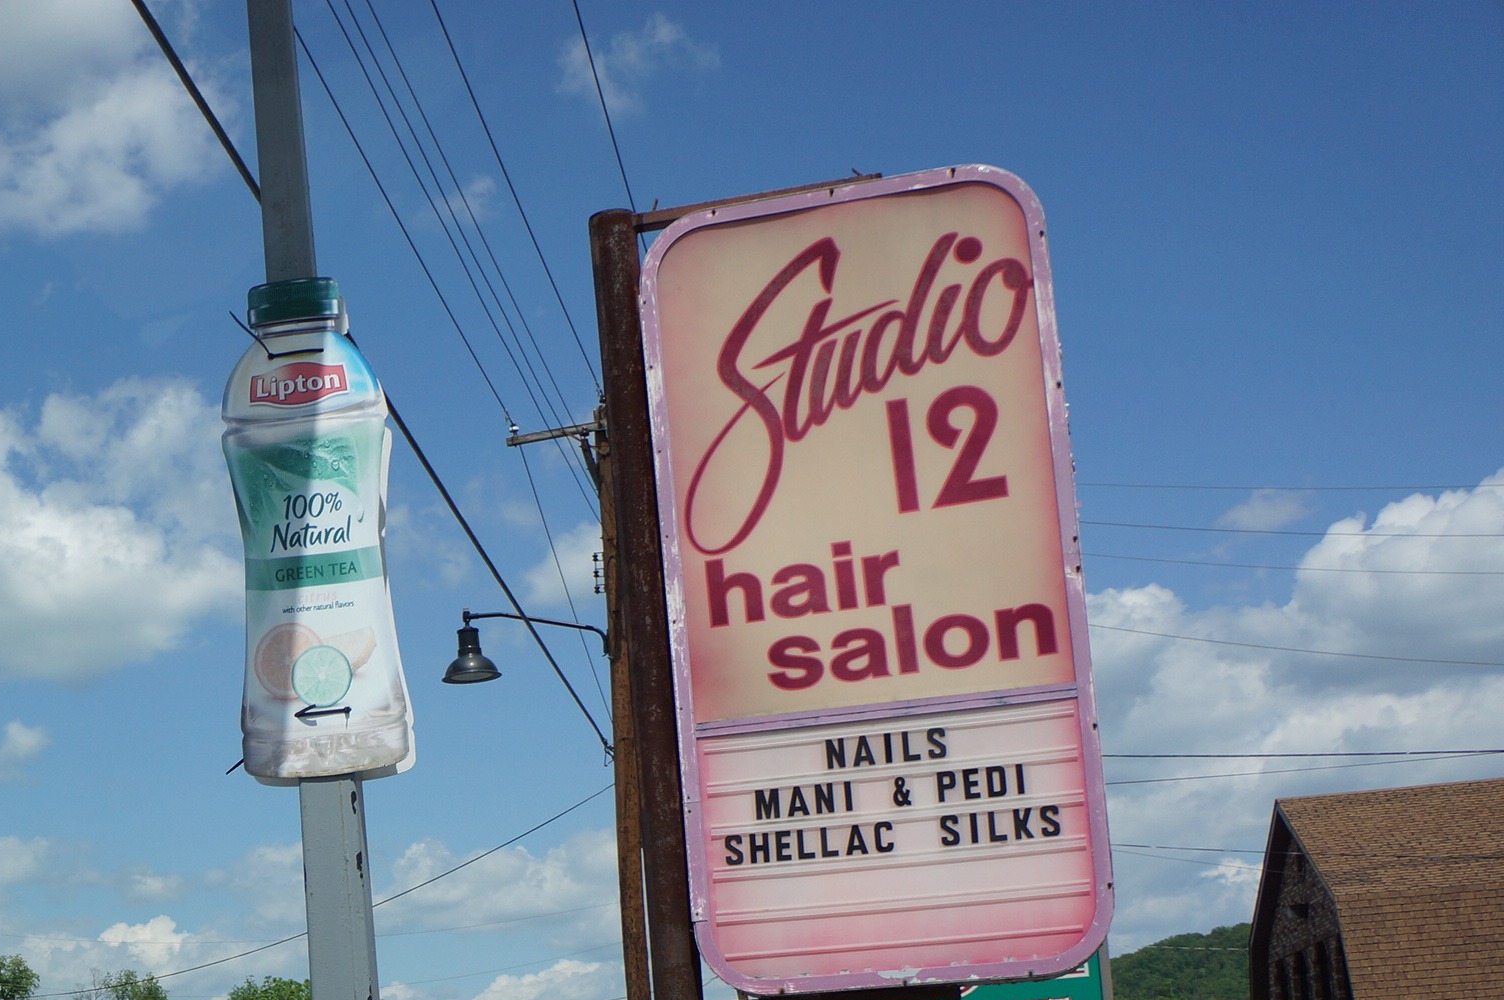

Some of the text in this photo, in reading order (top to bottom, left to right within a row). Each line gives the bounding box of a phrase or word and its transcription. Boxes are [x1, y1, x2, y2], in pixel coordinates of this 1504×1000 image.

[256, 372, 342, 401] Lipton
[683, 231, 1034, 556] Studio
[884, 385, 1009, 515] 12
[282, 491, 343, 521] 100%
[270, 515, 352, 553] Natural
[275, 561, 358, 582] GREEN TEA
[704, 540, 901, 629] hair
[282, 600, 355, 614] with other natural flavors
[766, 601, 1060, 692] salon
[825, 727, 948, 770] NAILS
[755, 763, 1027, 821] MANI & PEDI
[724, 804, 1063, 866] SHELLAC SILKS
